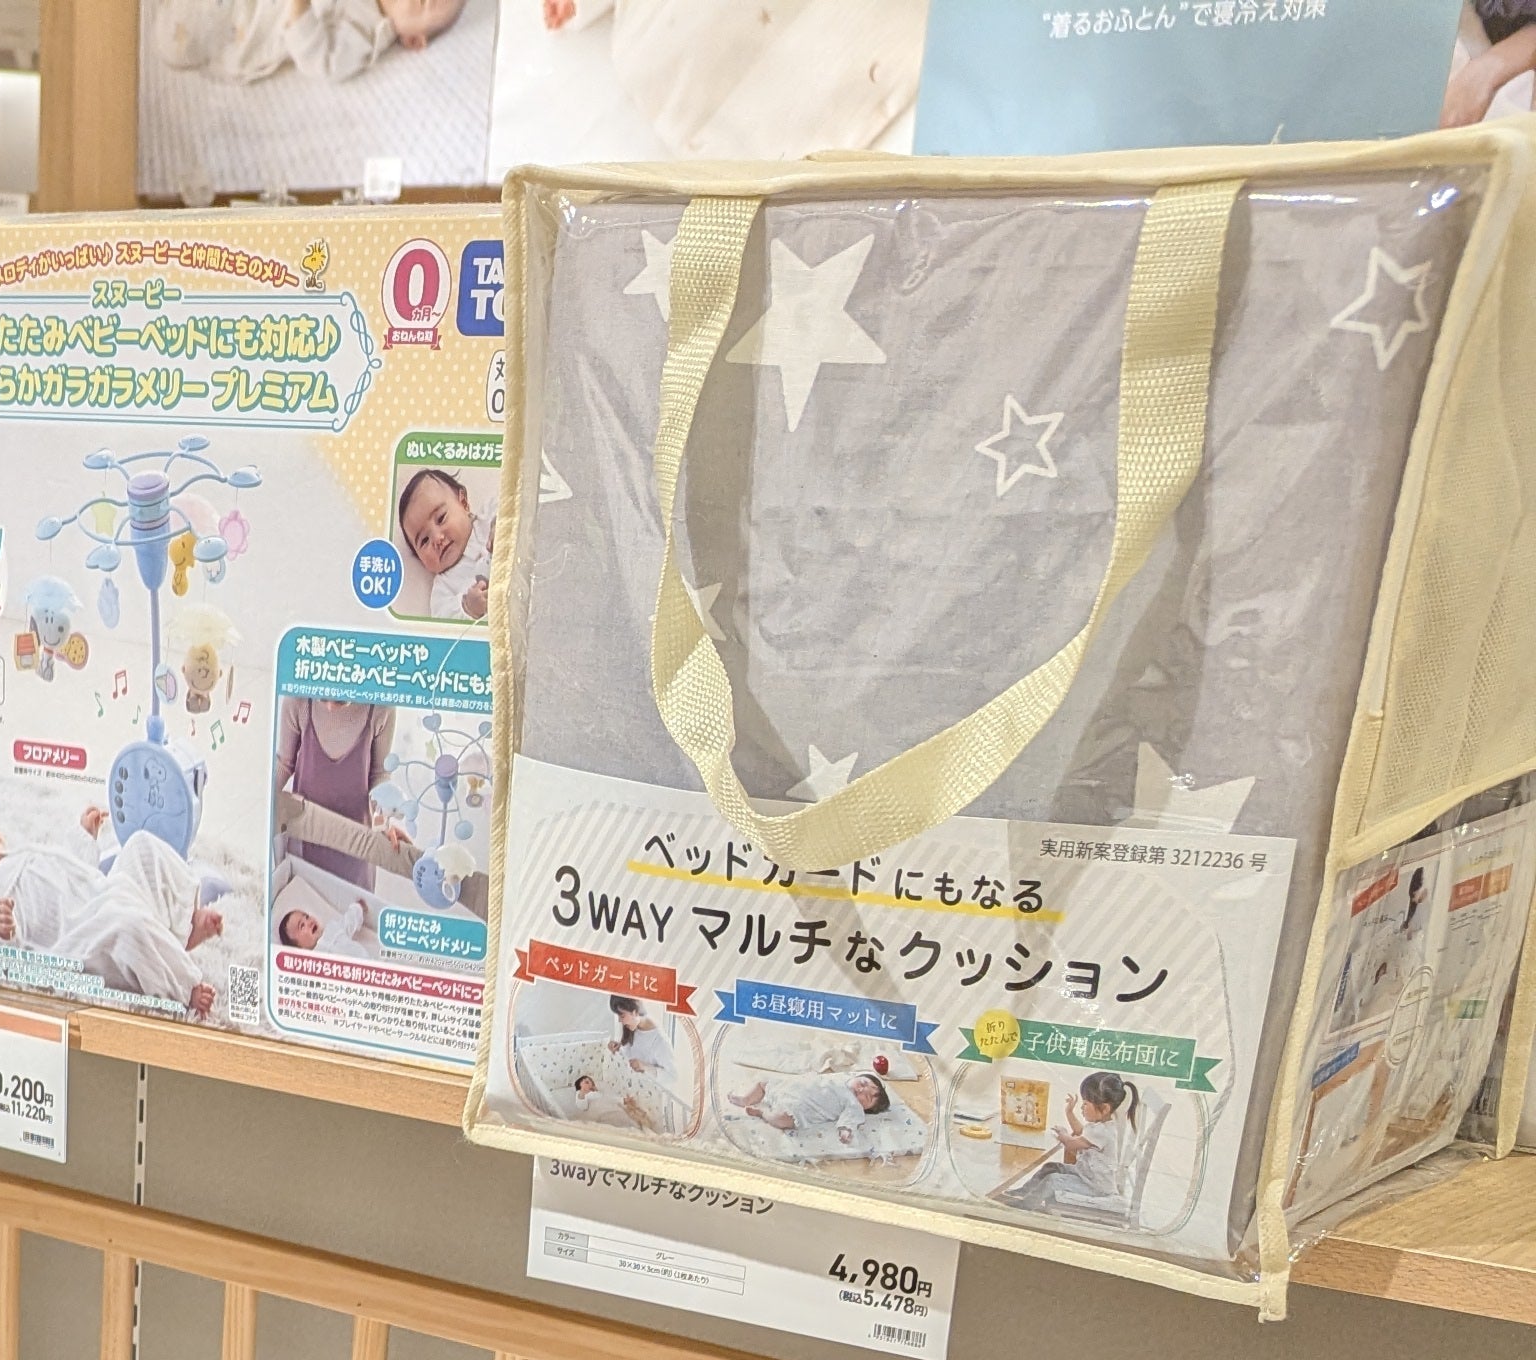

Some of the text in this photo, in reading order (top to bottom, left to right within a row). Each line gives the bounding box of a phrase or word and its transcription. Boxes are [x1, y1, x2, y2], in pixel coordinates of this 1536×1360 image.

[92, 280, 182, 309] スヌーピー
[210, 367, 339, 413] プレミアム
[359, 556, 396, 573] 手洗い
[360, 575, 393, 596] OK!
[295, 634, 429, 666] 木製ベビーベッドや
[22, 744, 81, 765] フロアメリー
[1040, 838, 1268, 872] 実用新案登録第 3212236 号
[384, 912, 442, 935] 折りたたみ
[552, 865, 1169, 1003] 3WAY マルチなクッション
[384, 931, 482, 957] ベビーベッドメリー
[283, 956, 486, 1002] 取り付けられる折りたたみベビーベッドにつ
[544, 956, 659, 993] ベッドガードに
[750, 992, 898, 1031] お昼寝用マットに
[1023, 1031, 1181, 1069] 子供用座布団に
[549, 1158, 774, 1216] 3wayでマルチなクッション
[557, 1231, 576, 1242] カラー
[828, 1253, 933, 1298] 4,980円
[838, 1289, 929, 1318] (税込5,478円)
